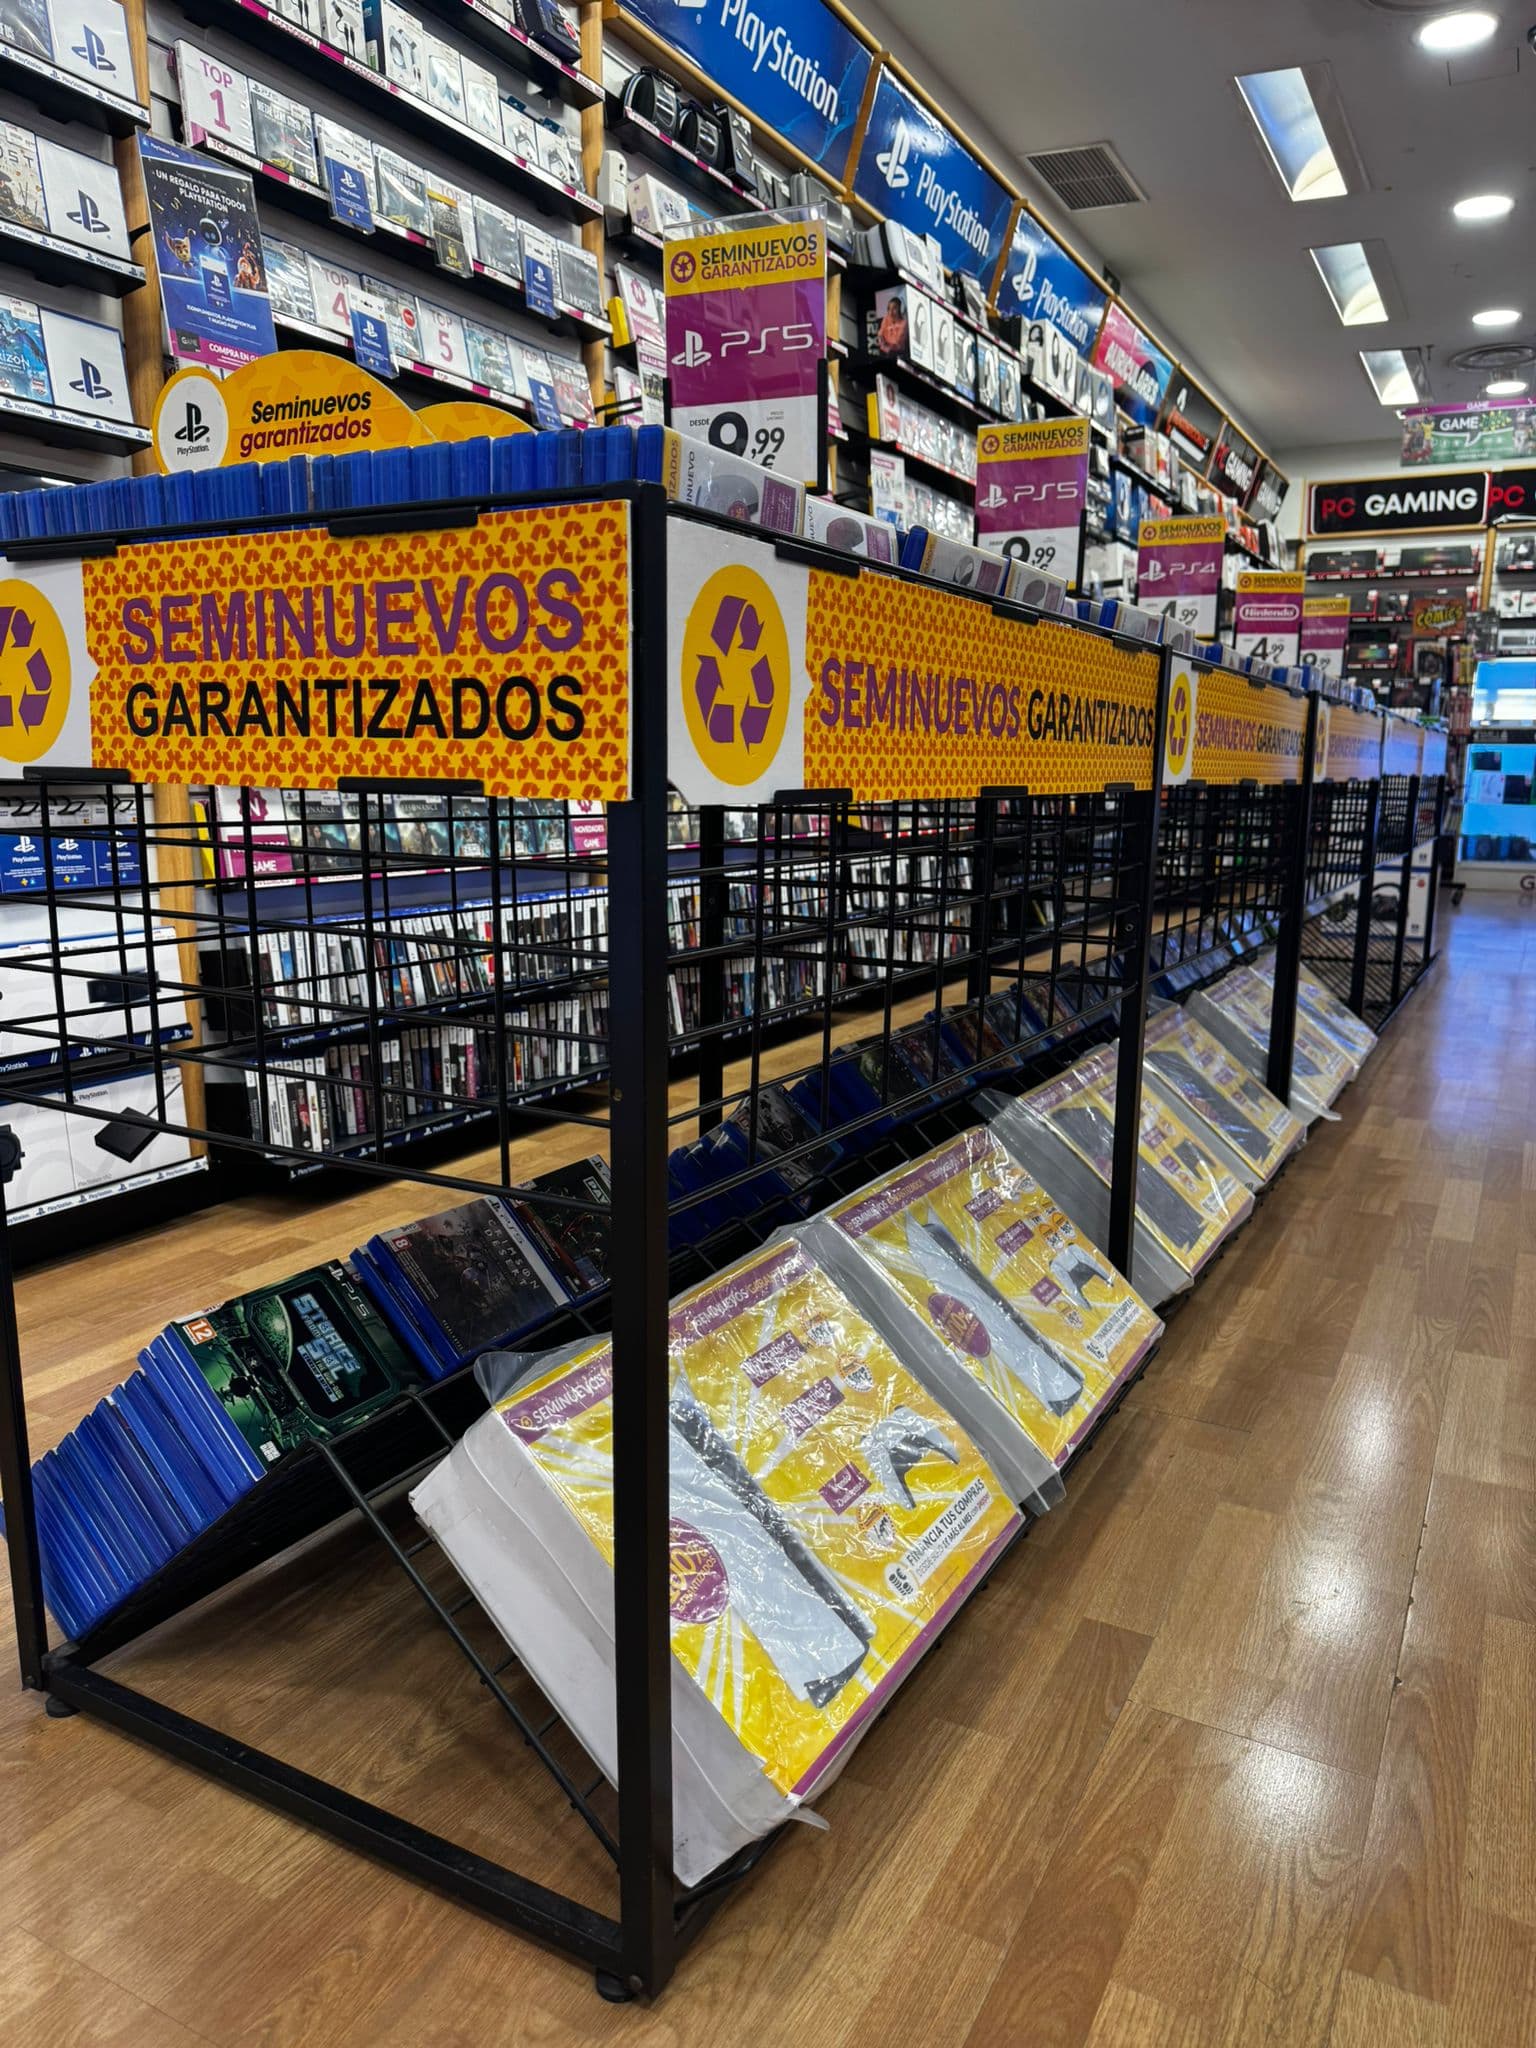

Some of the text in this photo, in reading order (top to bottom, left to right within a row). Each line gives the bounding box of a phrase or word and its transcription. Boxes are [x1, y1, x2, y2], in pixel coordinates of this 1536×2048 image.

[202, 60, 233, 88] TOP
[720, 0, 838, 124] PlayStation
[209, 89, 231, 132] 1
[156, 169, 168, 181] UN
[169, 175, 199, 194] REGALO
[201, 188, 221, 203] PARA
[221, 196, 247, 213] TODOS
[179, 188, 229, 213] PLAYSTATION
[916, 163, 989, 256] PlayStation
[701, 234, 817, 266] SEMINUEVOS
[701, 252, 817, 280] GARANTIZADOS
[1033, 278, 1088, 346] PlayStation
[720, 323, 813, 357] PS5
[251, 391, 371, 424] Seminuevos
[690, 418, 710, 427] DESDE
[1440, 416, 1479, 431] GAME
[177, 445, 209, 456] PlayStation
[240, 416, 372, 457] garantizados
[1002, 438, 1083, 453] GARANTIZADOS
[1003, 427, 1084, 444] SEMINUEVOS
[1014, 482, 1078, 503] PS5
[1321, 487, 1478, 520] PC GAMING
[1489, 486, 1525, 508] PC
[1160, 522, 1221, 533] SEMINUEVOS
[1169, 562, 1216, 576] PS4
[122, 568, 583, 664] SEMINUEVOS
[1244, 608, 1294, 617] Nintendo
[126, 675, 584, 741] GARANTIZADOS
[820, 657, 1153, 748] SEMINUEVOS GARANTIZADOS
[1197, 713, 1257, 751] SEMINUEVOS
[574, 825, 604, 833] NOVEDADES
[584, 838, 600, 848] GAME
[12, 856, 40, 864] PlayStation
[79, 1090, 109, 1101] PlayStation
[484, 1229, 528, 1287] DESERT
[341, 1281, 370, 1317] PS5
[694, 1286, 749, 1327] SEMINUEVOS
[191, 1321, 213, 1341] 12
[532, 1376, 606, 1425] SEMINUEVOS
[907, 1478, 986, 1566] FINANCIA TUS COMPRAS
[678, 1557, 717, 1612] GARANTIZADOS
